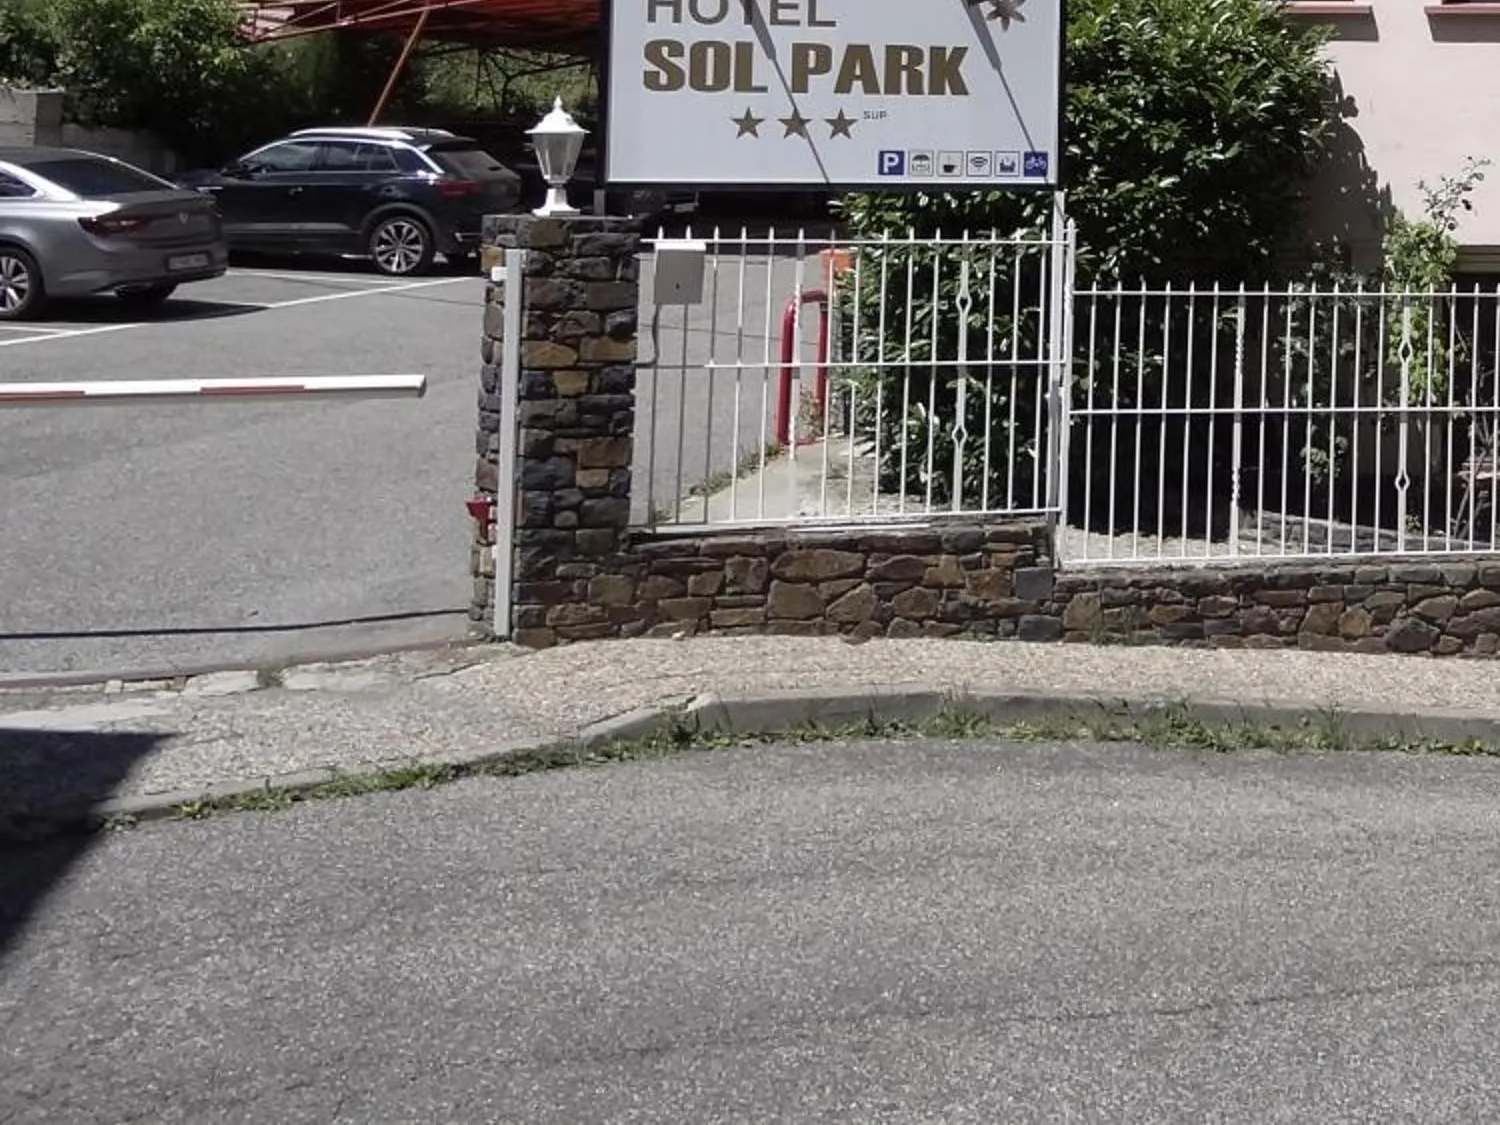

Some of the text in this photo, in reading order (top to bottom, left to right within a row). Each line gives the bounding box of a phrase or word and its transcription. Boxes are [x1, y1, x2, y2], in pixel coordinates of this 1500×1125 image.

[643, 39, 970, 96] SOL PARK
[863, 110, 887, 120] SUP
[882, 153, 900, 173] P
